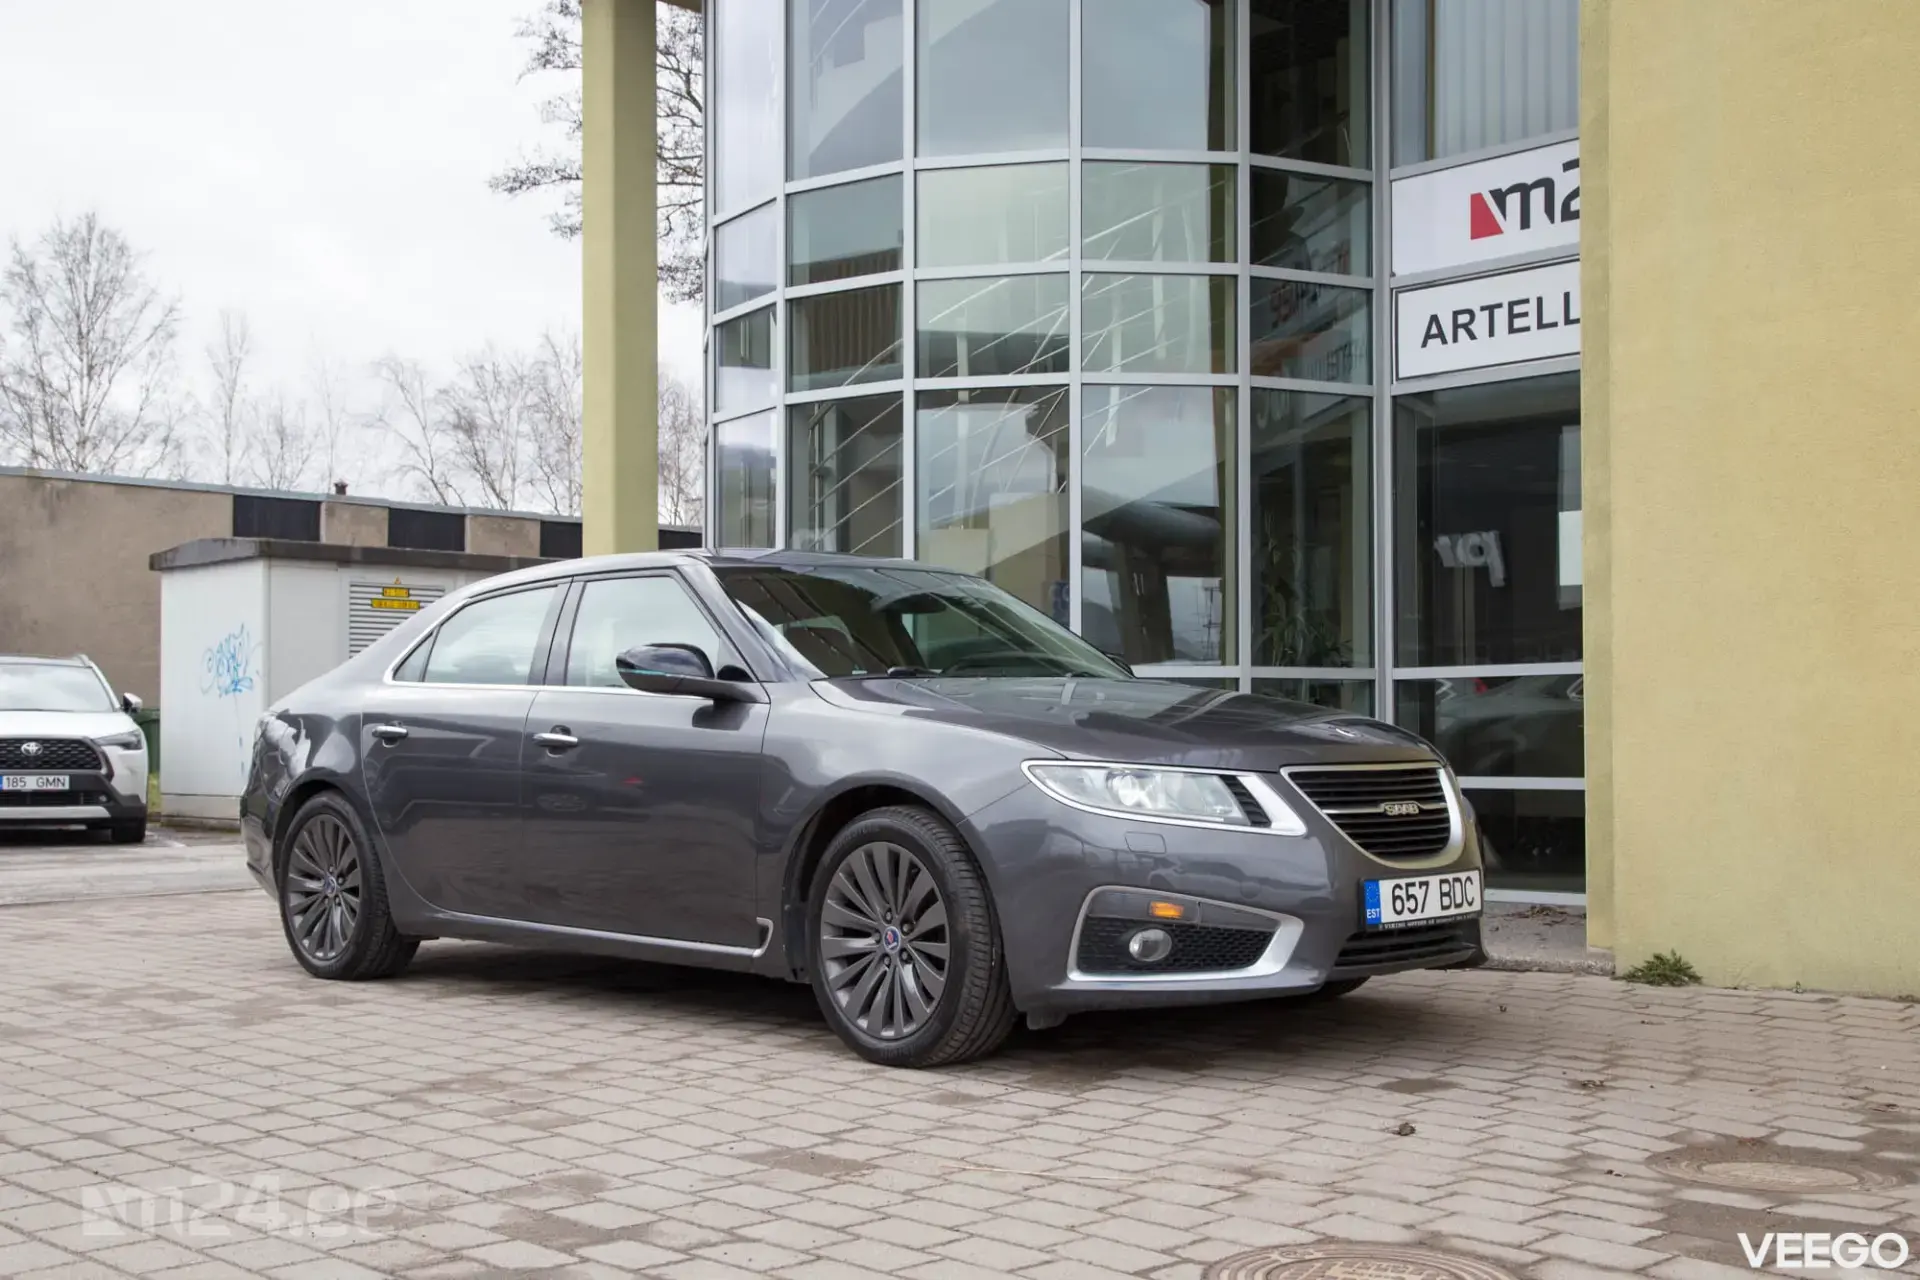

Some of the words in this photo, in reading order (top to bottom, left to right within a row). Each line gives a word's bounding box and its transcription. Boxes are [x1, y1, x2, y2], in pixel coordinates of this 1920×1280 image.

[1420, 291, 1580, 349] ARTELL
[5, 777, 27, 788] 185
[36, 777, 66, 788] GMN
[1384, 803, 1420, 816] SAAB
[1391, 880, 1430, 916] 657
[1439, 875, 1475, 912] BDC
[1366, 908, 1381, 919] EST
